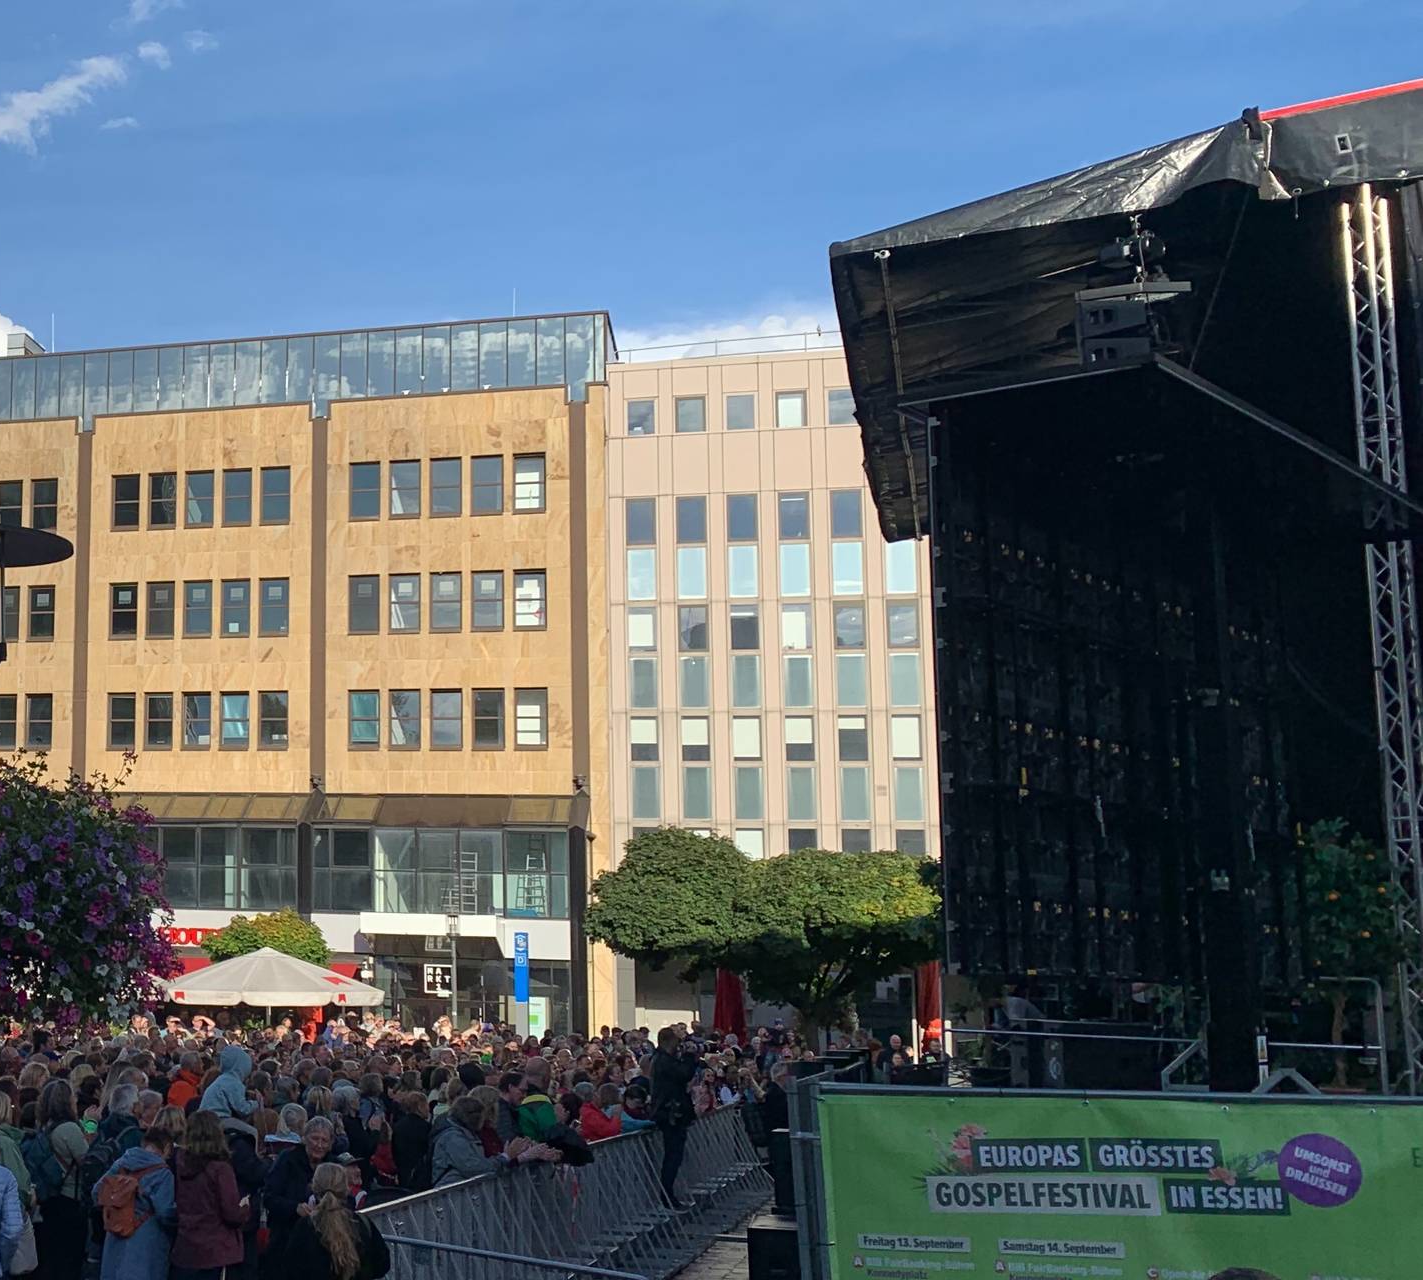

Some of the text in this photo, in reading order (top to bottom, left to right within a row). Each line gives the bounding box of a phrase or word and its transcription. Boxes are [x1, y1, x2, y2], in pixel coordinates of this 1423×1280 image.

[979, 1139, 1216, 1169] EUROPAS GRÖSSTES
[1294, 1146, 1352, 1175] UMSONST
[1285, 1166, 1348, 1197] DRAUSSEN
[1309, 1165, 1331, 1178] und
[935, 1181, 1284, 1210] GOSPELFESTIVAL IN ESSEN!
[863, 1235, 964, 1250] Freitag 13. September
[1003, 1240, 1117, 1255] Samstag 14. September
